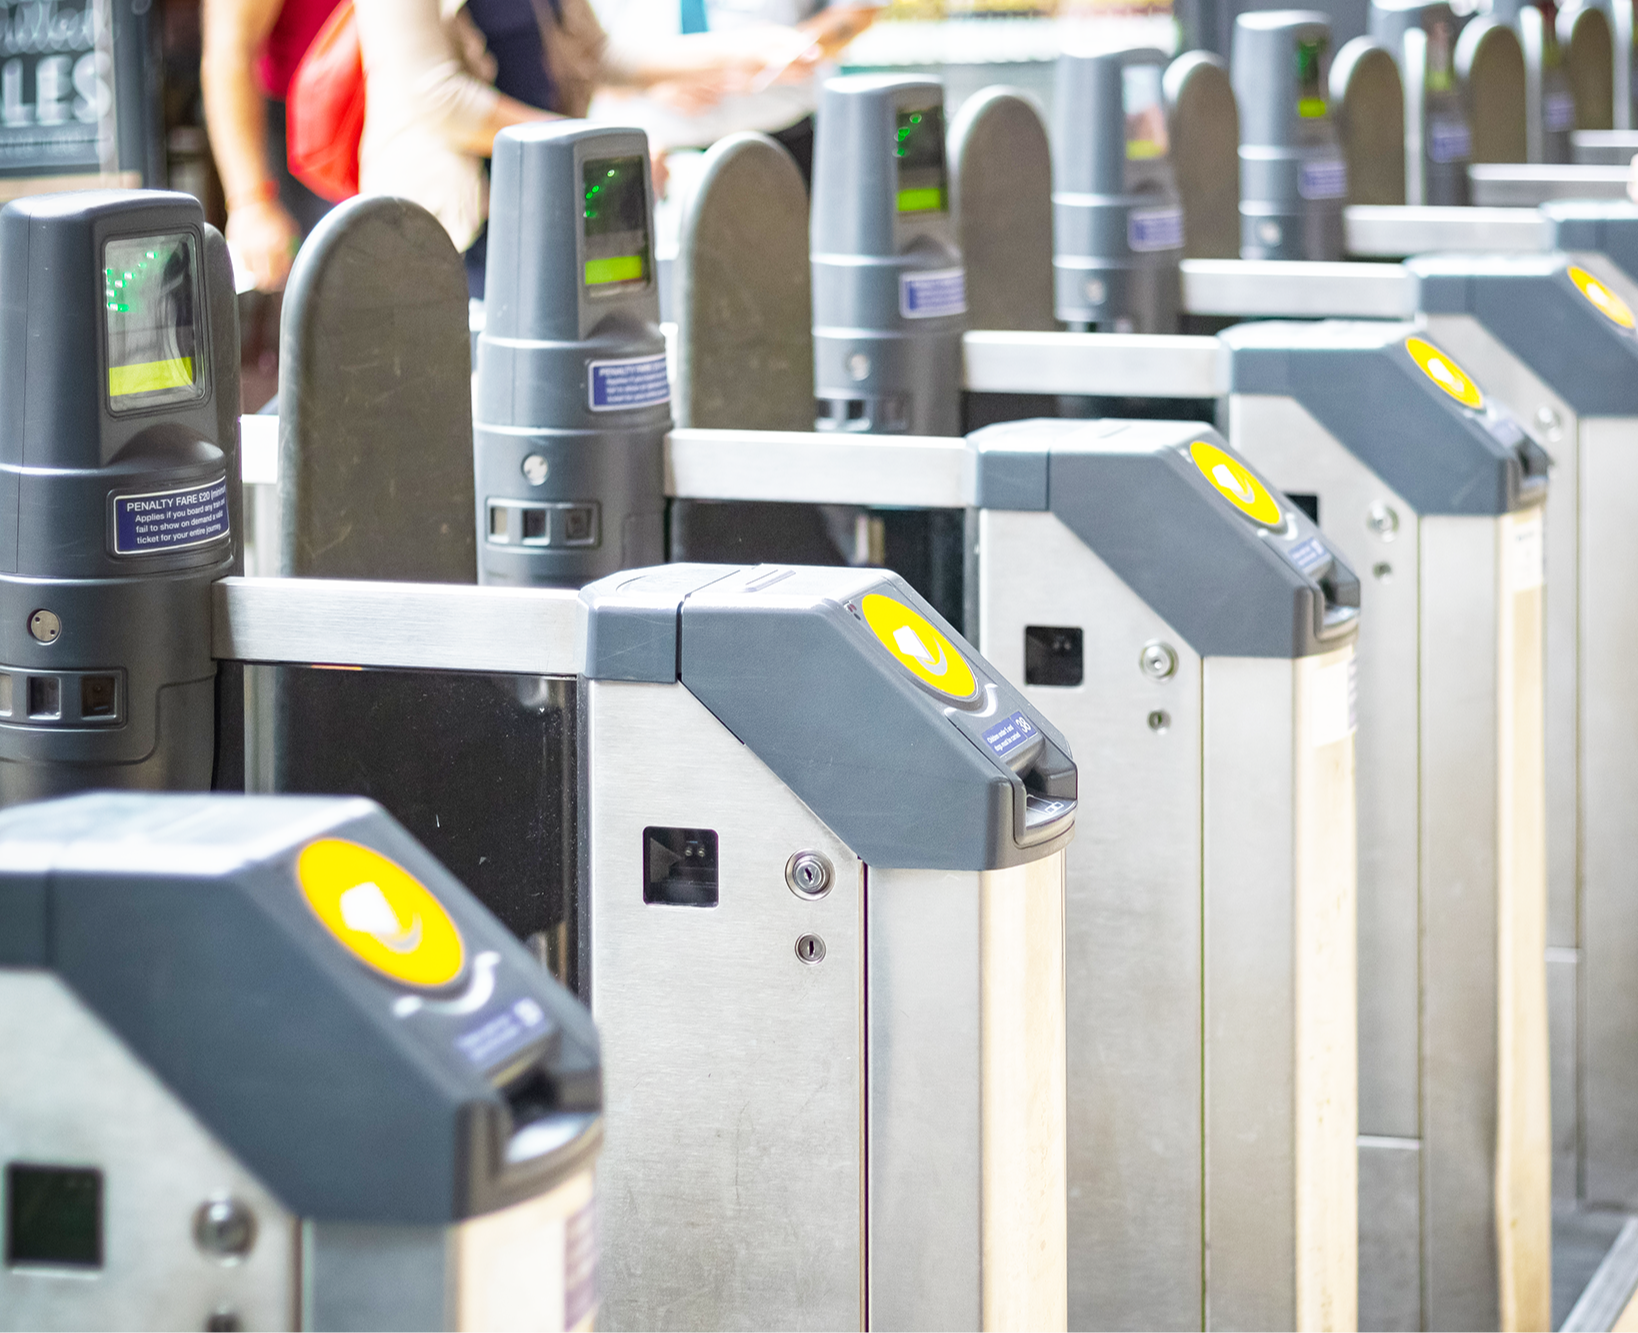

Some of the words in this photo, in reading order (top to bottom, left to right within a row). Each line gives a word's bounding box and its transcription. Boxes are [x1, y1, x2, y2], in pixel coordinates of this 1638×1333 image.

[127, 498, 174, 512] PENALTY
[176, 494, 198, 506] FARE
[199, 490, 211, 502] £20
[135, 512, 165, 523] Applies
[166, 510, 172, 519] if
[173, 511, 185, 519] you
[187, 505, 204, 516] board
[136, 525, 149, 533] fail
[150, 524, 159, 532] to
[160, 522, 180, 531] show
[181, 520, 190, 528] on
[191, 514, 212, 526] demand
[137, 535, 159, 544] ticket
[161, 533, 172, 541] for
[173, 532, 188, 541] your
[189, 528, 206, 537] entire
